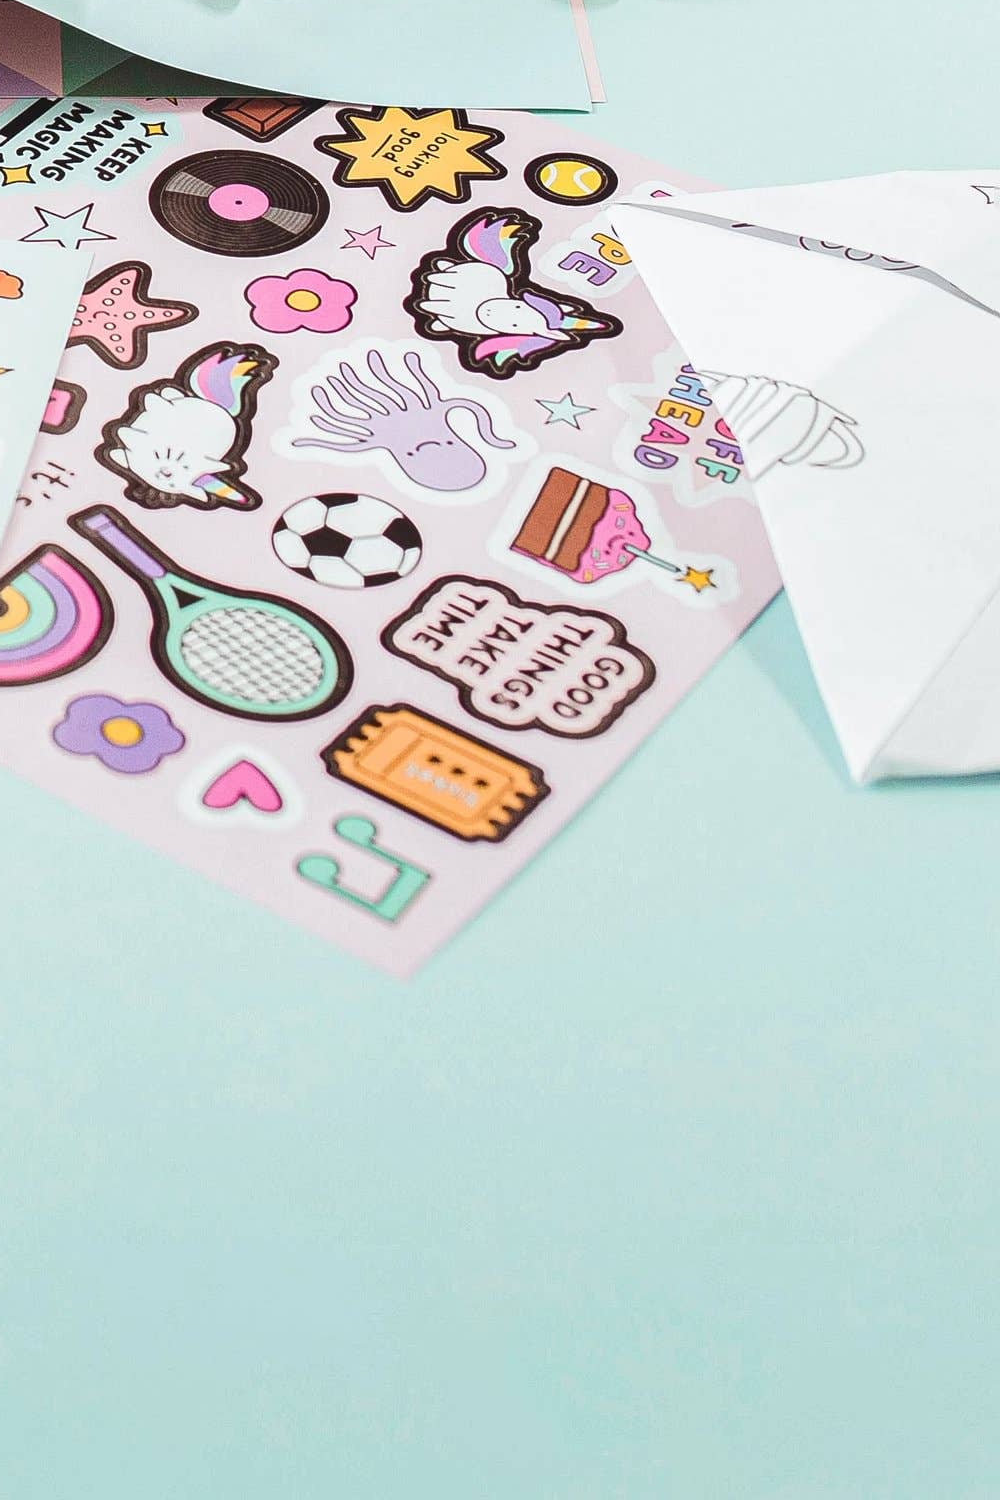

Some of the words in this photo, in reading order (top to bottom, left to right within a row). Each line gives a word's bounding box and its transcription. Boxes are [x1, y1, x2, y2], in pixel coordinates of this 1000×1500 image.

[15, 102, 95, 160] MAGIC
[39, 109, 136, 182] MAKING
[94, 137, 152, 182] KEEP
[382, 127, 421, 163] good
[394, 132, 460, 178] looking
[557, 224, 633, 287] PE
[634, 361, 713, 470] HEAD
[411, 593, 489, 652] TIME
[457, 615, 534, 676] TAKE
[490, 623, 595, 711] THINGS
[552, 656, 625, 719] GOOD
